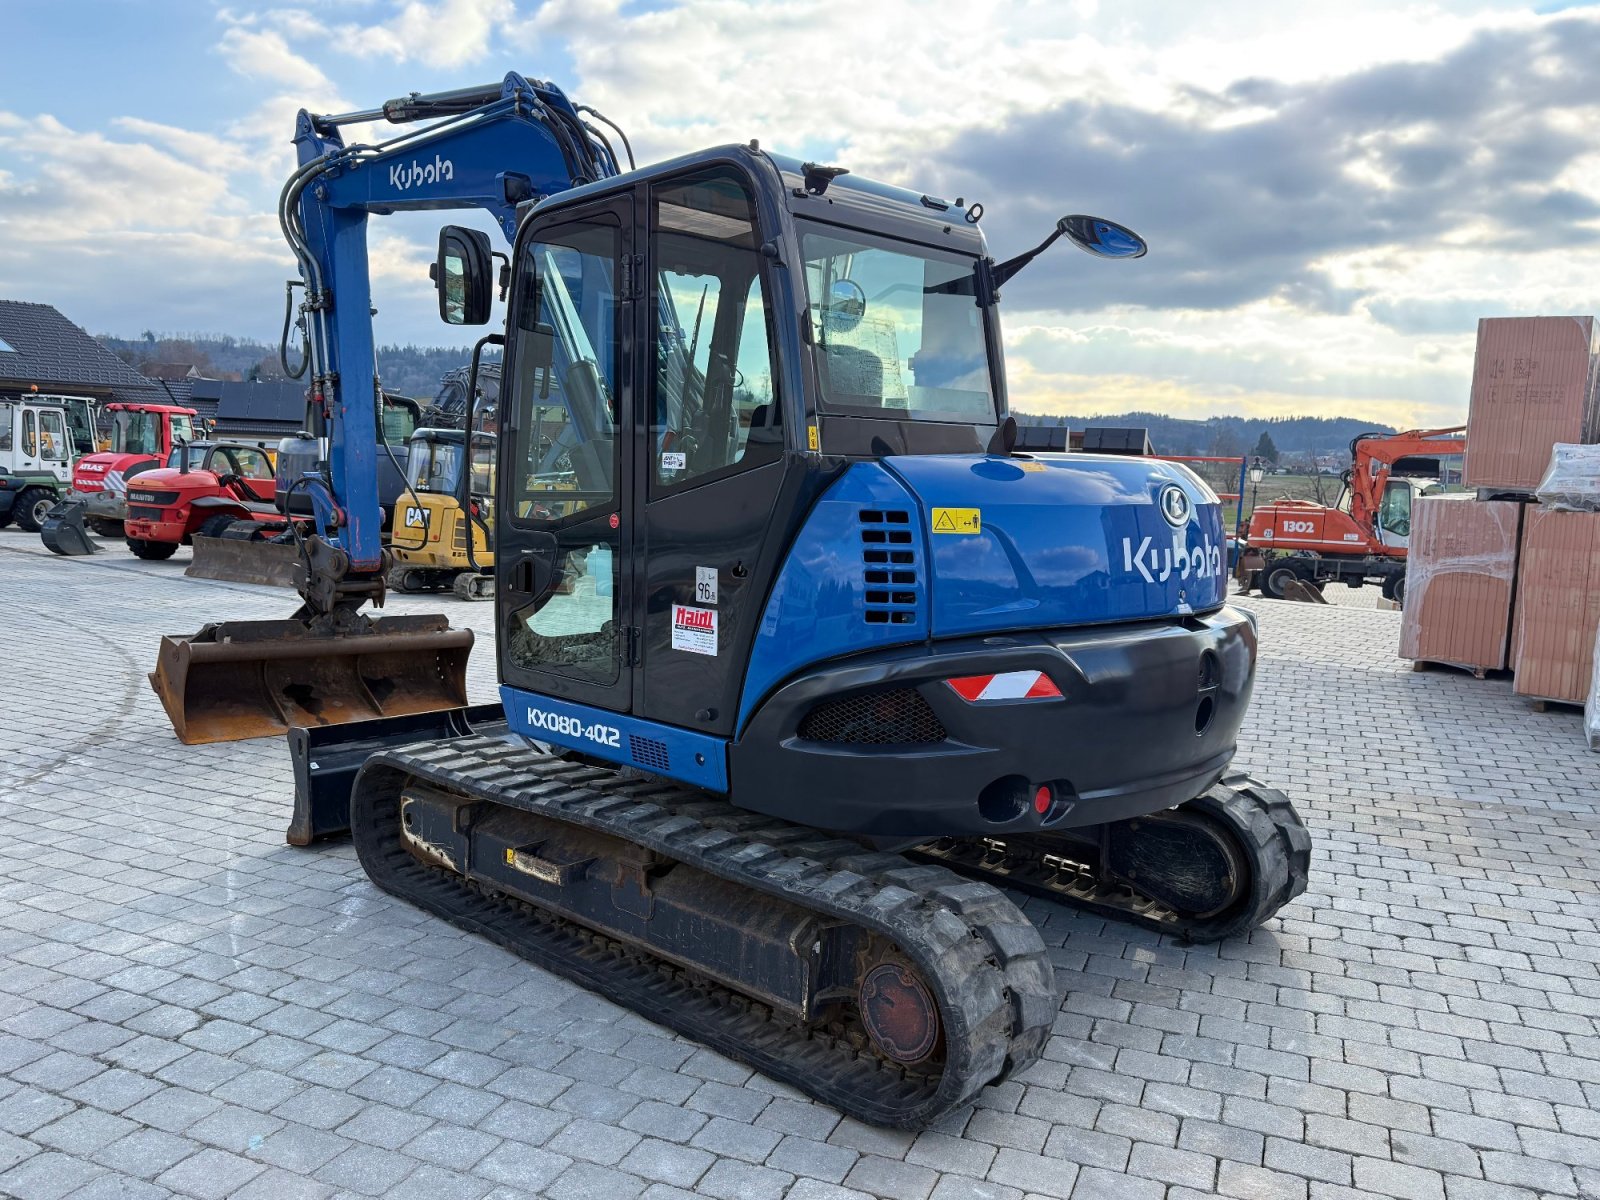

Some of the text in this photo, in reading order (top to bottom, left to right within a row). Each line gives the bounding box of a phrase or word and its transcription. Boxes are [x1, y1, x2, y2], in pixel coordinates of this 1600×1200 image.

[390, 155, 453, 190] Kubota
[79, 463, 104, 472] ATLAS
[130, 493, 155, 502] MANITOU
[406, 507, 430, 527] CAT
[1283, 520, 1315, 533] 1302
[1123, 533, 1221, 583] Kubota
[698, 582, 710, 600] 96
